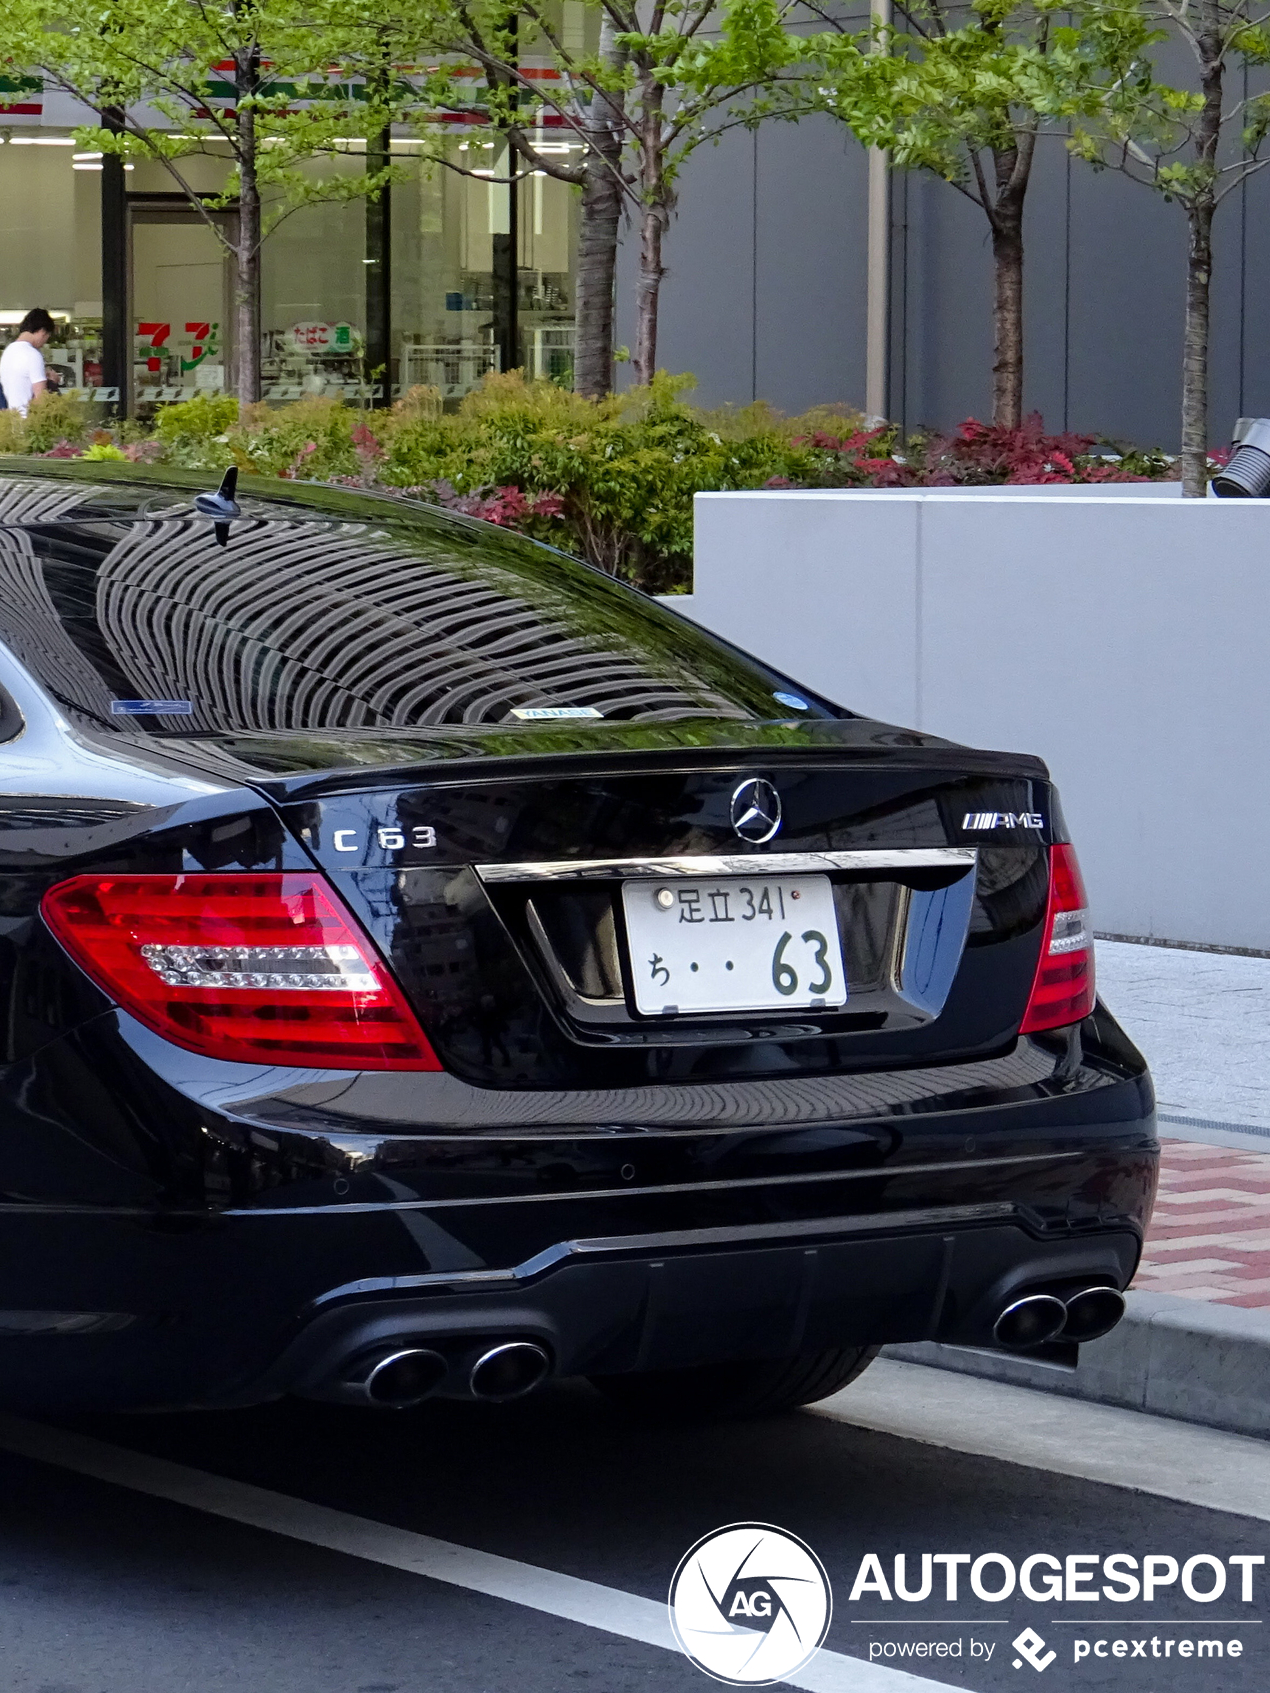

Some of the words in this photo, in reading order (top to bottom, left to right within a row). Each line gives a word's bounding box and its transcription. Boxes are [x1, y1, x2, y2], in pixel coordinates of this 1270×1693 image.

[293, 325, 329, 345] たばこ
[519, 708, 597, 718] YANASE
[333, 829, 359, 852] C
[376, 825, 437, 850] 63
[772, 929, 833, 996] 63
